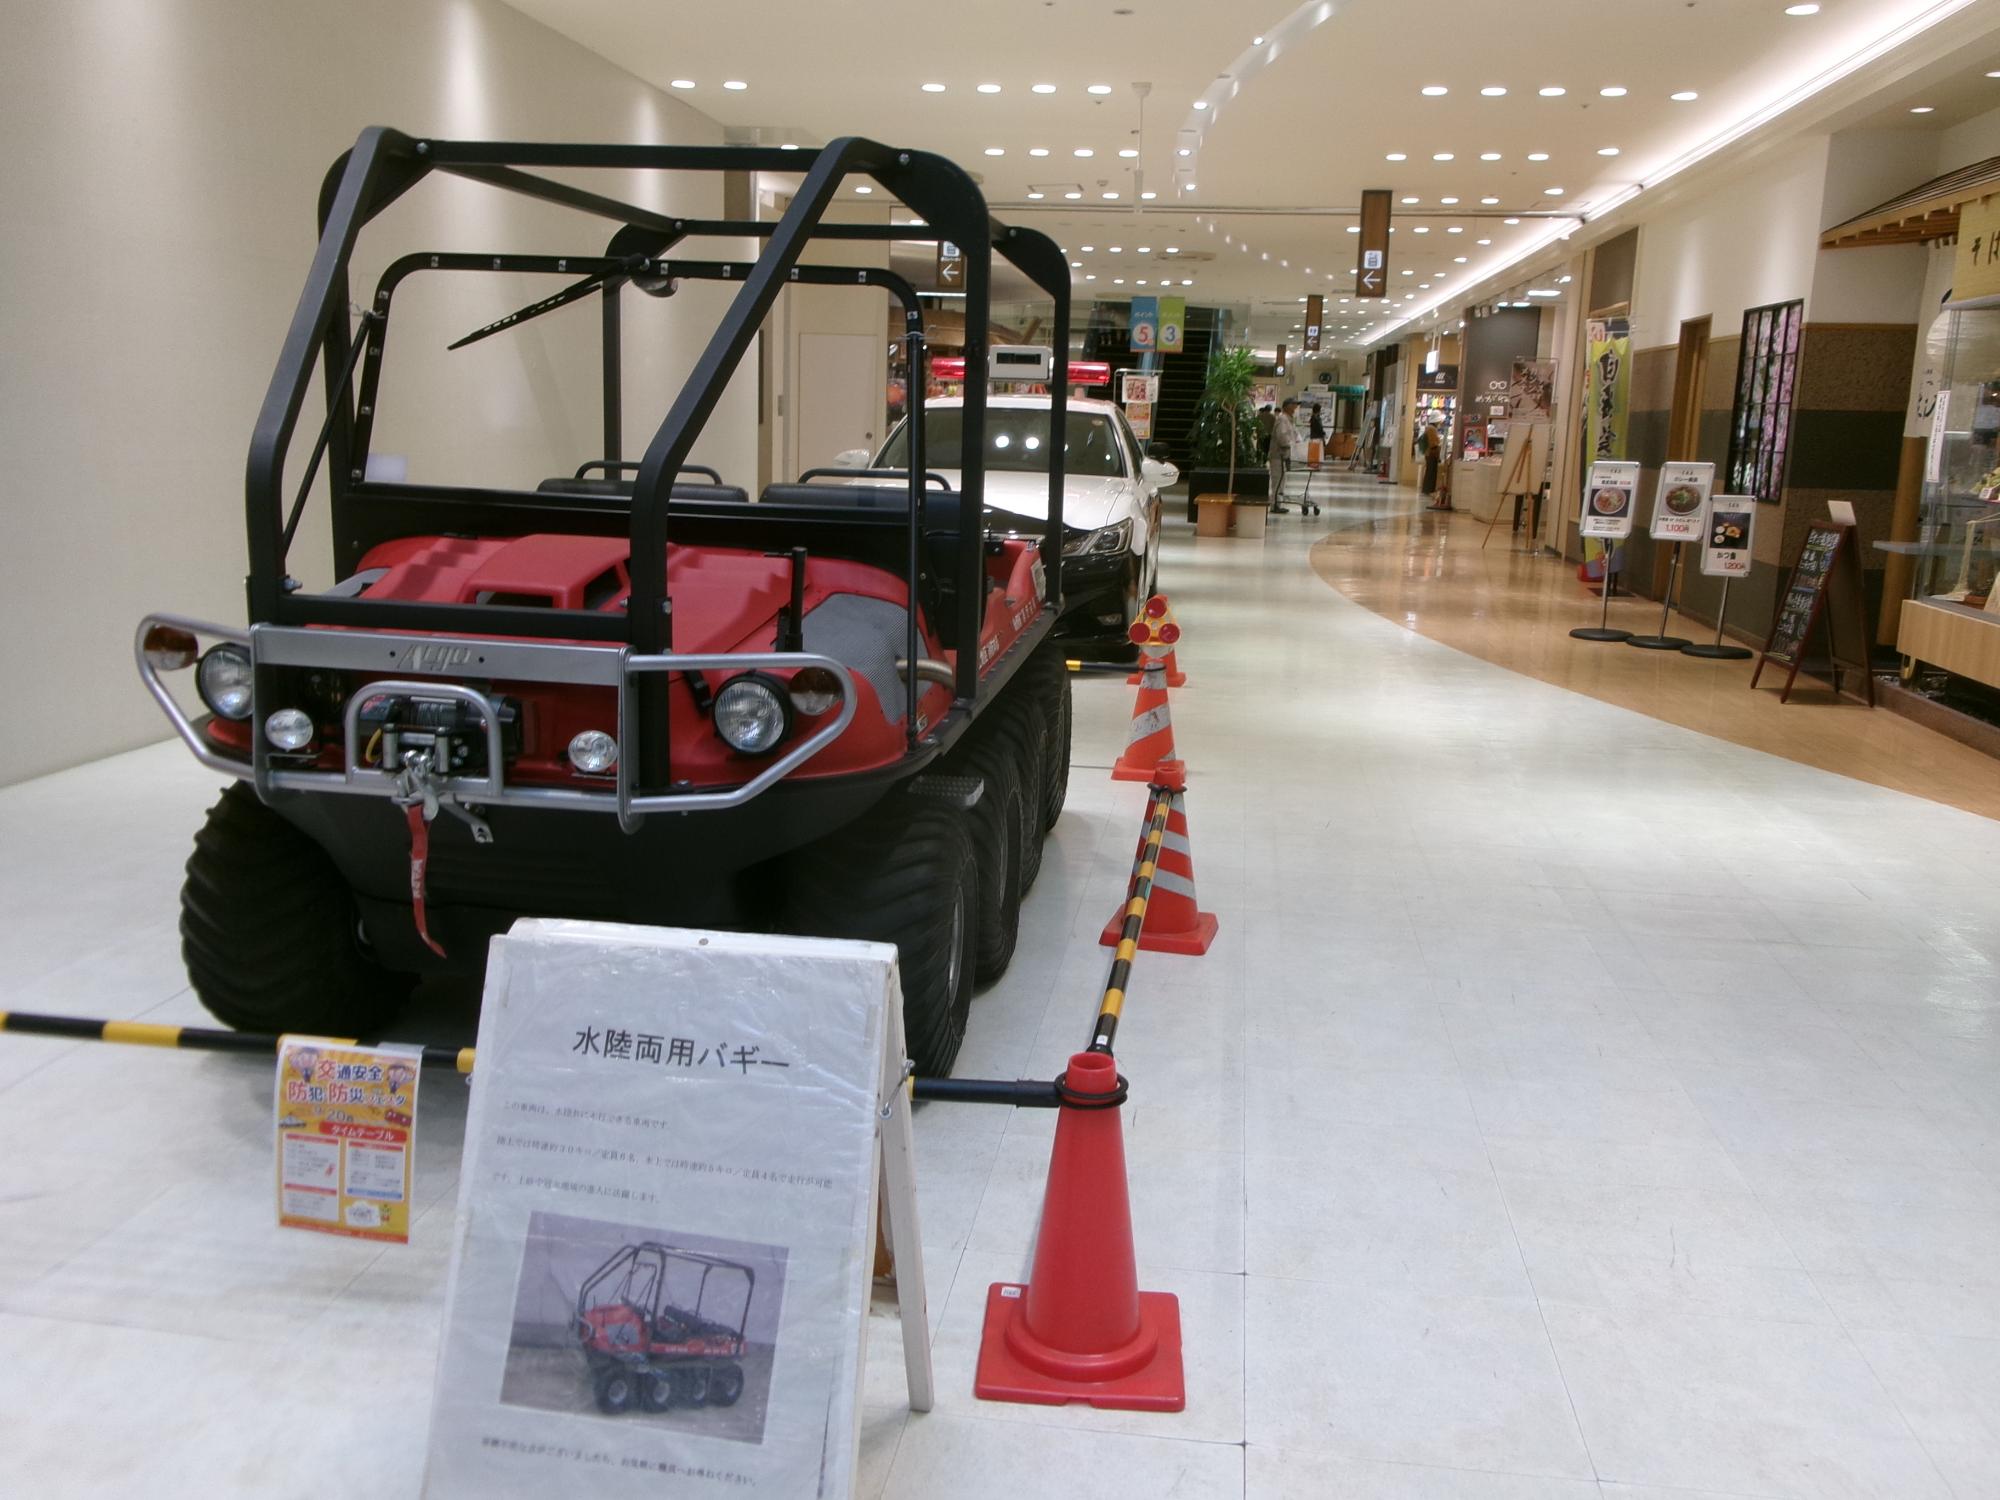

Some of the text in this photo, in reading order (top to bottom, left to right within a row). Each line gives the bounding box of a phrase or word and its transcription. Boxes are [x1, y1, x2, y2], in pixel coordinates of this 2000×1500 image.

[572, 1025, 790, 1075] 水陸両用バギー
[318, 1059, 382, 1082] 交通安全
[331, 1125, 395, 1141] タイムテーブル
